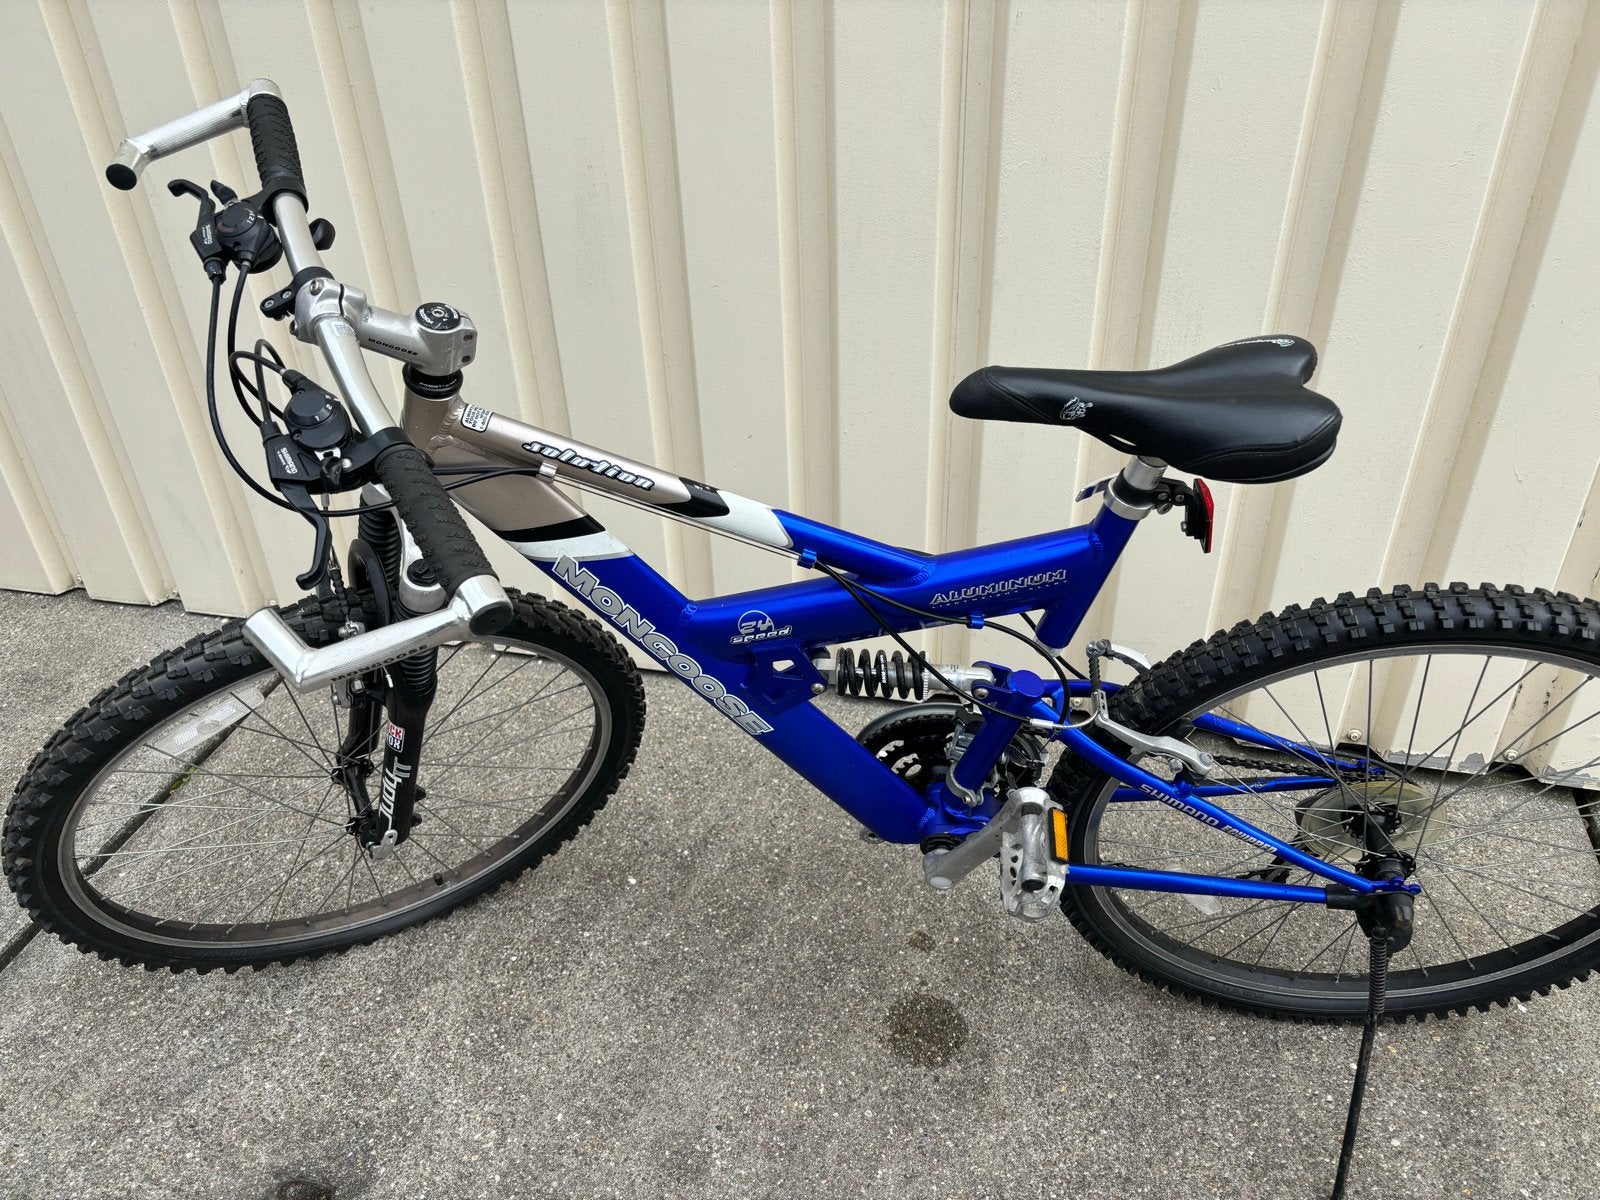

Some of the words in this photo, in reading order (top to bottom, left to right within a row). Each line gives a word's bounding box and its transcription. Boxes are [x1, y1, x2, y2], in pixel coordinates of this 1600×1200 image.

[368, 338, 419, 357] MONGOOSE
[521, 441, 655, 491] solution
[929, 569, 1067, 605] ALUMINUM
[552, 555, 774, 735] MONGOOSE
[739, 617, 773, 635] 24
[331, 644, 428, 682] MONGOOSE
[1138, 783, 1220, 827] SHIMANO
[1219, 824, 1278, 854] EQUIPPED
